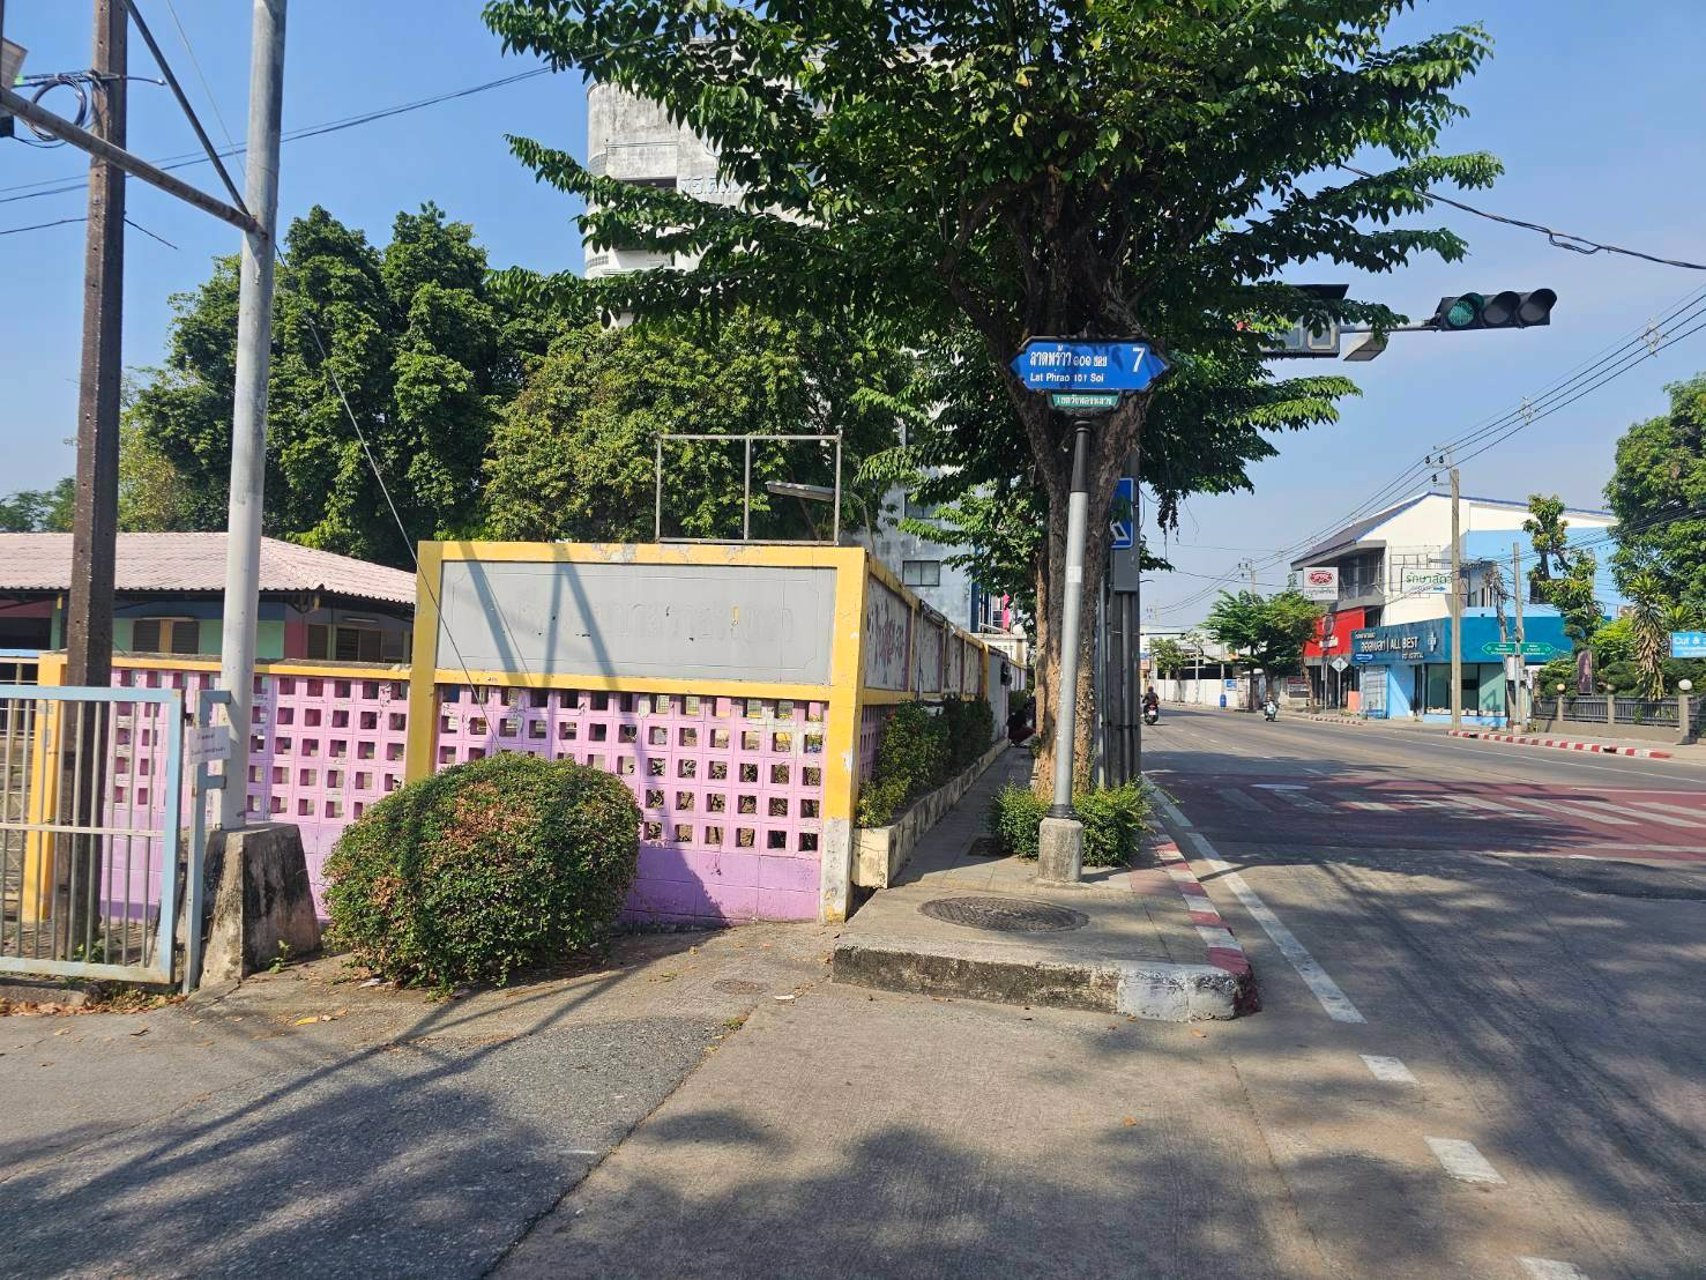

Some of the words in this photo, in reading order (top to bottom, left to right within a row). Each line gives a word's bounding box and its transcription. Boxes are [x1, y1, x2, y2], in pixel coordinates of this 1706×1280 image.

[1030, 344, 1072, 367] ลาดพร้าว
[1073, 355, 1091, 367] ๑๐๑
[1132, 346, 1145, 373] 7
[1030, 373, 1043, 382] Lat
[1046, 372, 1070, 382] Phrao
[1074, 373, 1087, 382] 101
[1090, 372, 1104, 382] Soi
[1390, 642, 1401, 650] ALL
[1401, 636, 1418, 650] BEST
